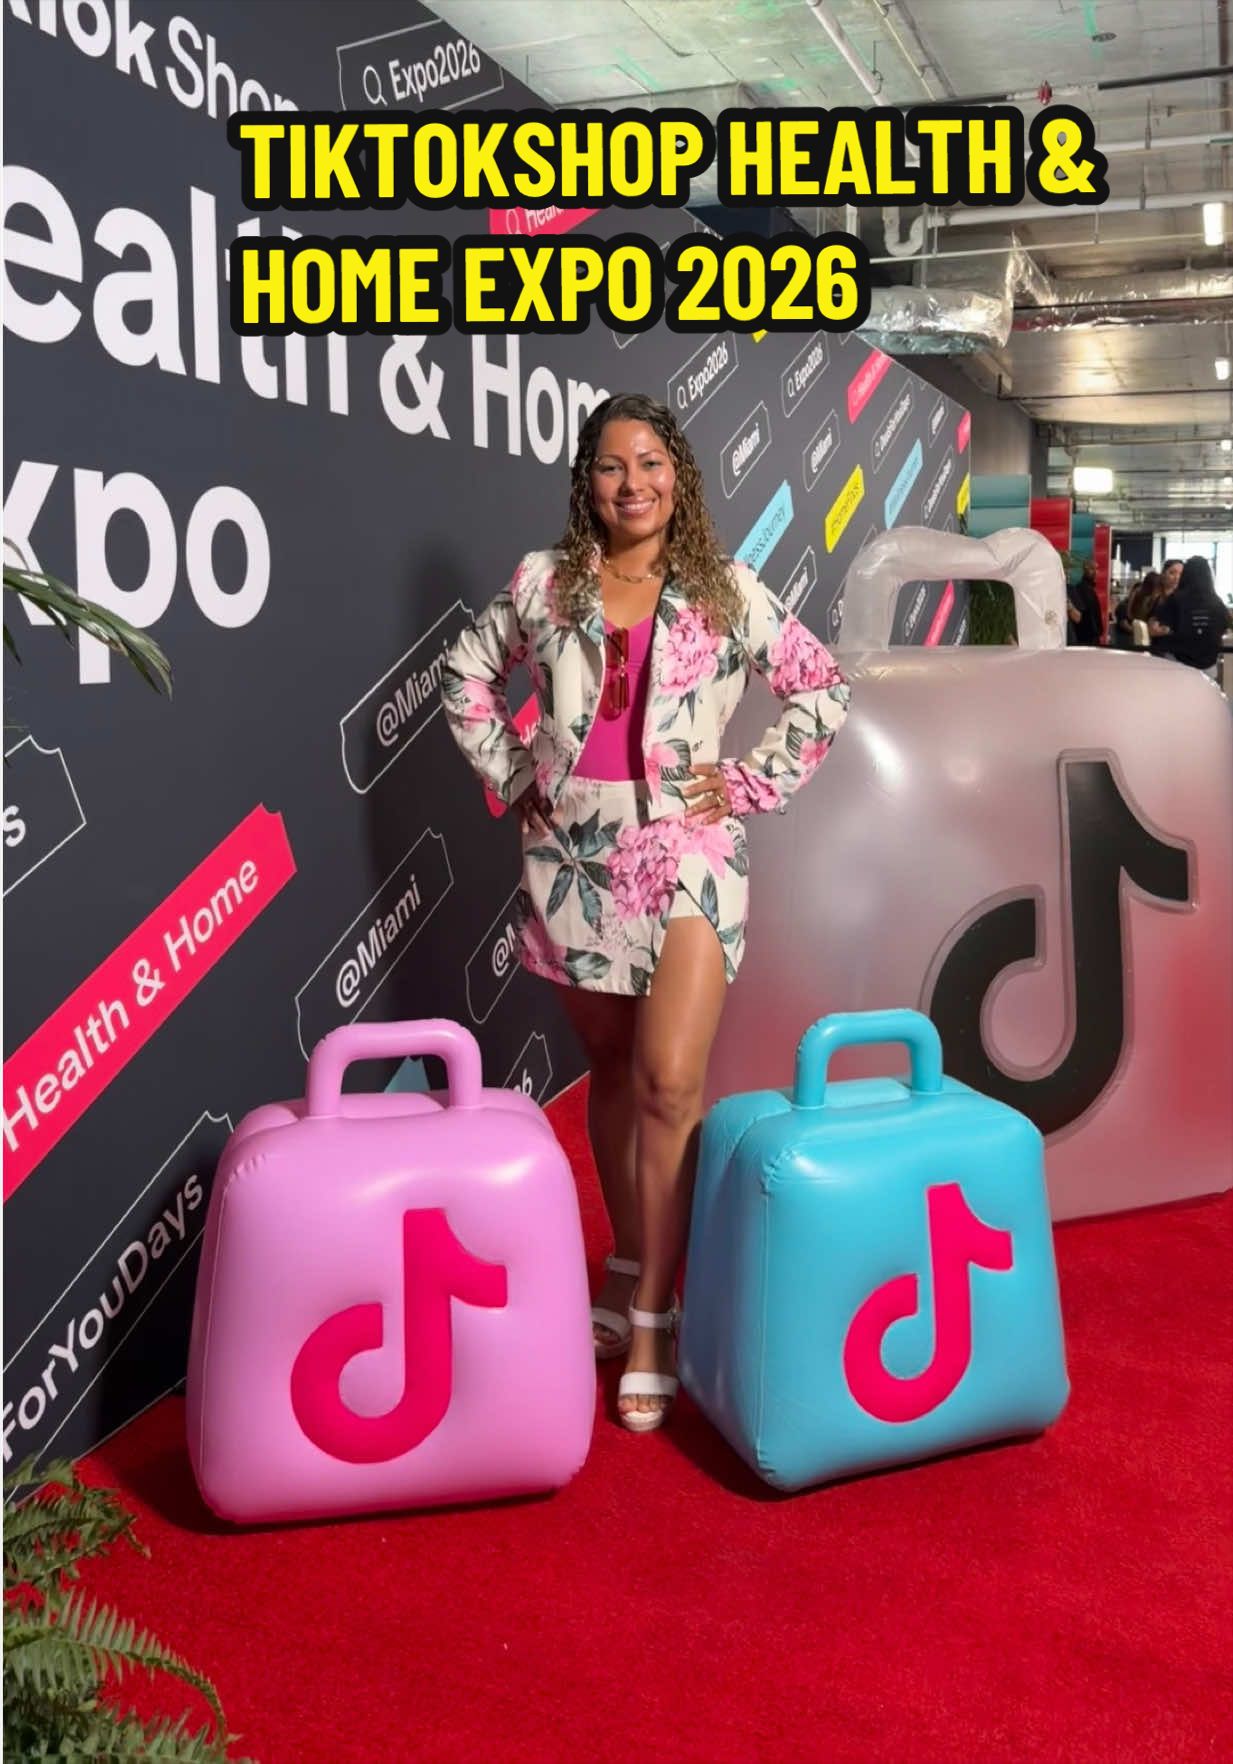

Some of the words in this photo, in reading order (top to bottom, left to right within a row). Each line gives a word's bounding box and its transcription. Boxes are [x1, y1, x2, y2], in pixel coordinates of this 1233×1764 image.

[388, 39, 481, 103] Expo2026
[687, 340, 729, 401] Expo2026
[732, 422, 760, 477] @Miami
[336, 874, 421, 1008] @Miami
[3, 1000, 130, 1152] Health
[131, 959, 165, 1007] &
[162, 859, 260, 972] Home
[3, 1174, 204, 1463] ForYouDays
